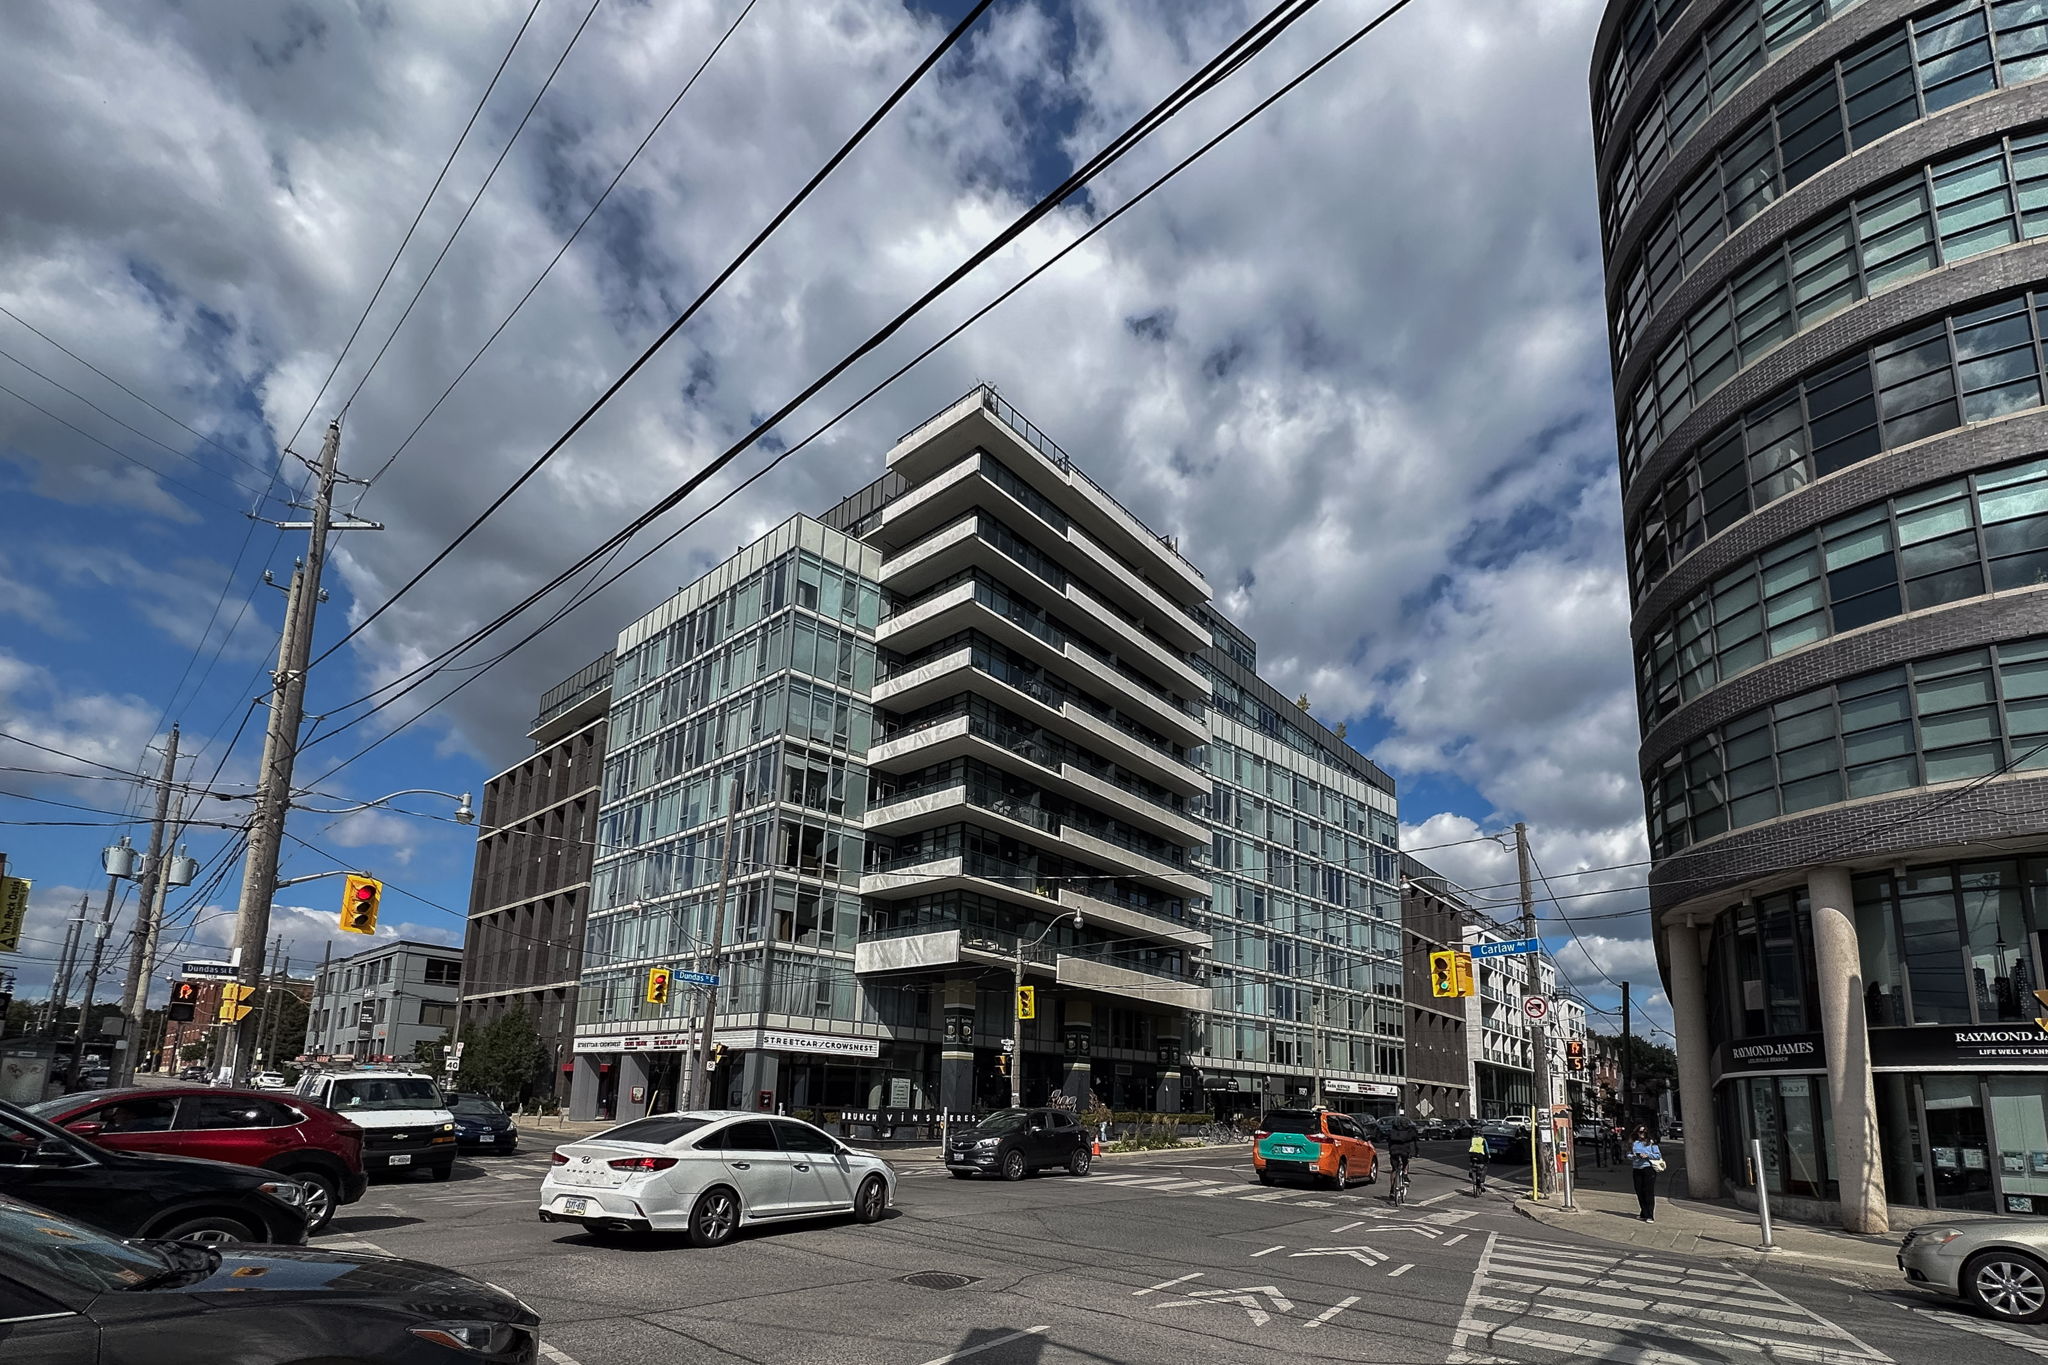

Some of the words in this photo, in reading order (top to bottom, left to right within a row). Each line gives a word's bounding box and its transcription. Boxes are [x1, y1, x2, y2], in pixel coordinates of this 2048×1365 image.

[8, 881, 20, 900] Oasis
[4, 902, 15, 919] Rock
[1, 920, 12, 934] The
[1481, 943, 1515, 954] Carlaw
[187, 965, 218, 974] Dundas
[680, 971, 704, 981] Dundas
[1954, 1031, 2033, 1042] RAYMOND
[1733, 1045, 1774, 1059] RAYMOND
[1774, 1042, 1814, 1055] JAMES
[1574, 1058, 1581, 1069] 5
[842, 1112, 877, 1122] BRUNCH
